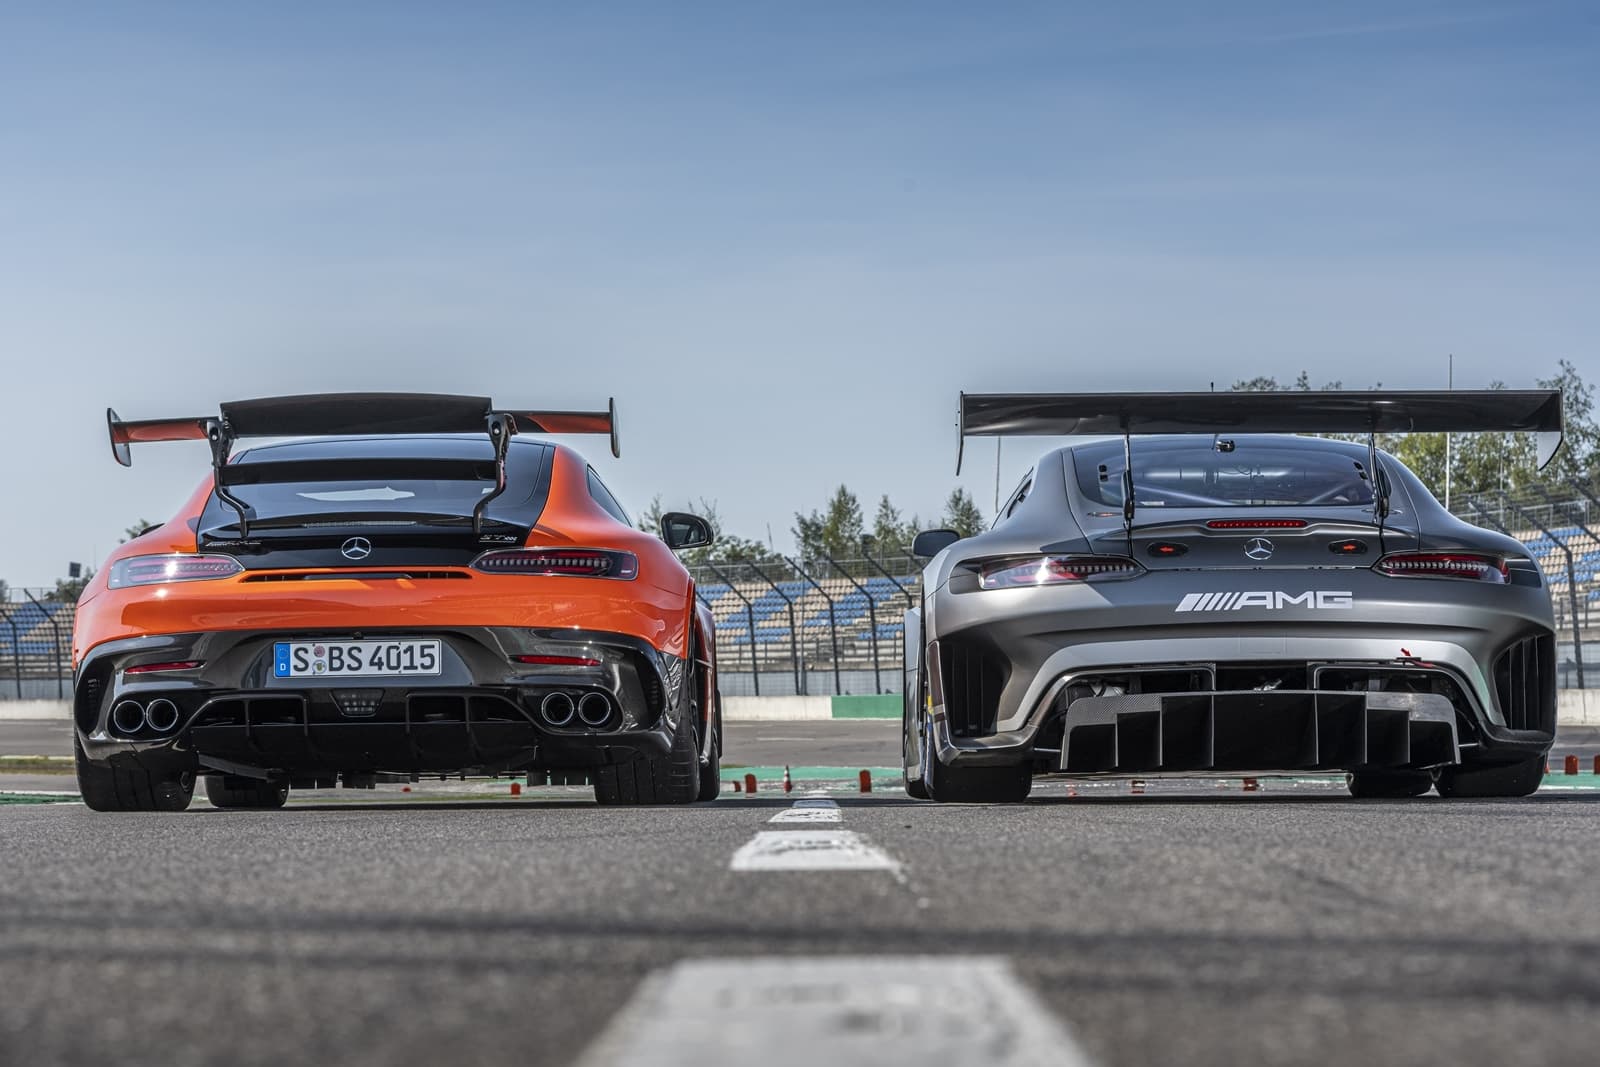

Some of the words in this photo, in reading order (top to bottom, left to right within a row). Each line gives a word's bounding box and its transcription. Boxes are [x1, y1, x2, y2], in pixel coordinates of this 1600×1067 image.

[1232, 591, 1353, 610] AMG
[279, 663, 287, 671] D
[293, 647, 309, 672] S
[328, 646, 363, 672] BS
[369, 644, 435, 671] 4015
